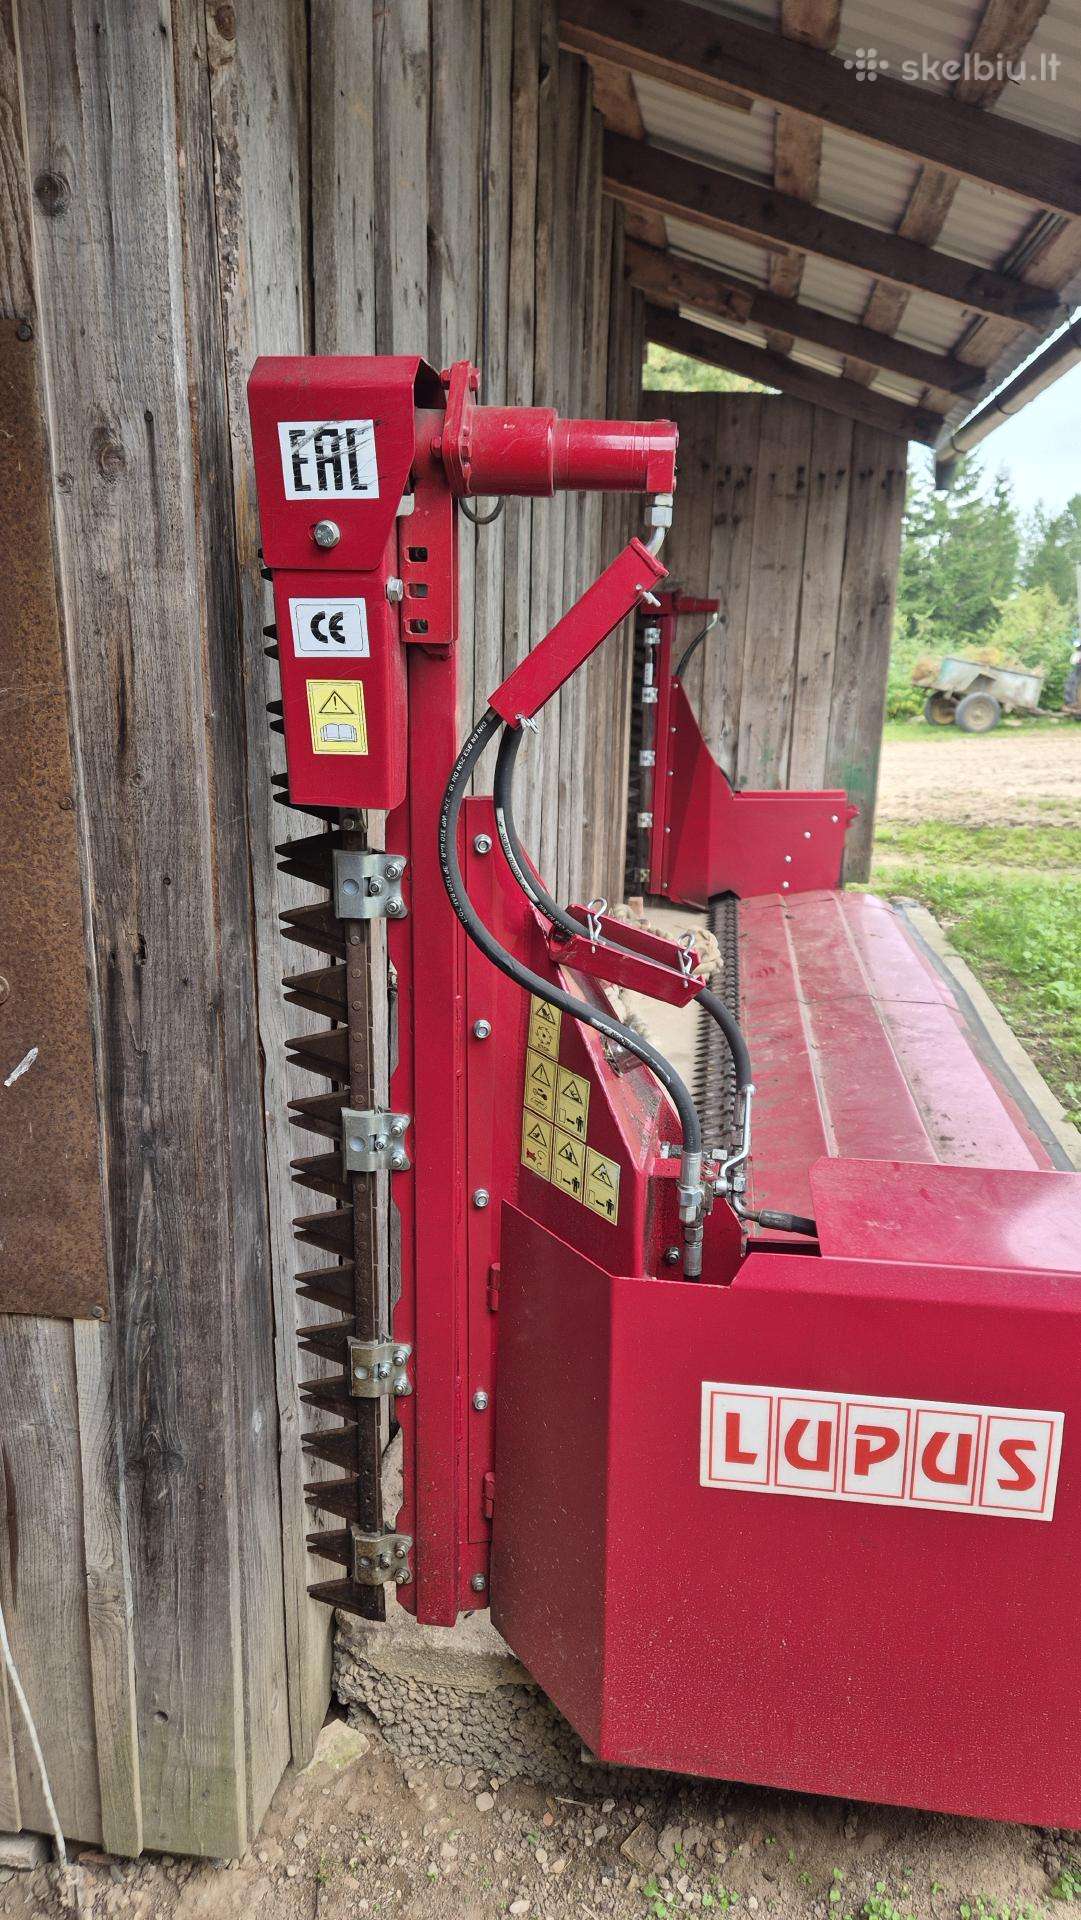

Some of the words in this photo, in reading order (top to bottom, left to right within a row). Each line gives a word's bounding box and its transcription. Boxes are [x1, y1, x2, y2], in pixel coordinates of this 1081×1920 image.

[310, 610, 346, 644] CE
[476, 721, 488, 734] DIN
[470, 733, 479, 744] EN
[463, 743, 473, 757] 853
[724, 1412, 1037, 1492] LUPUS
